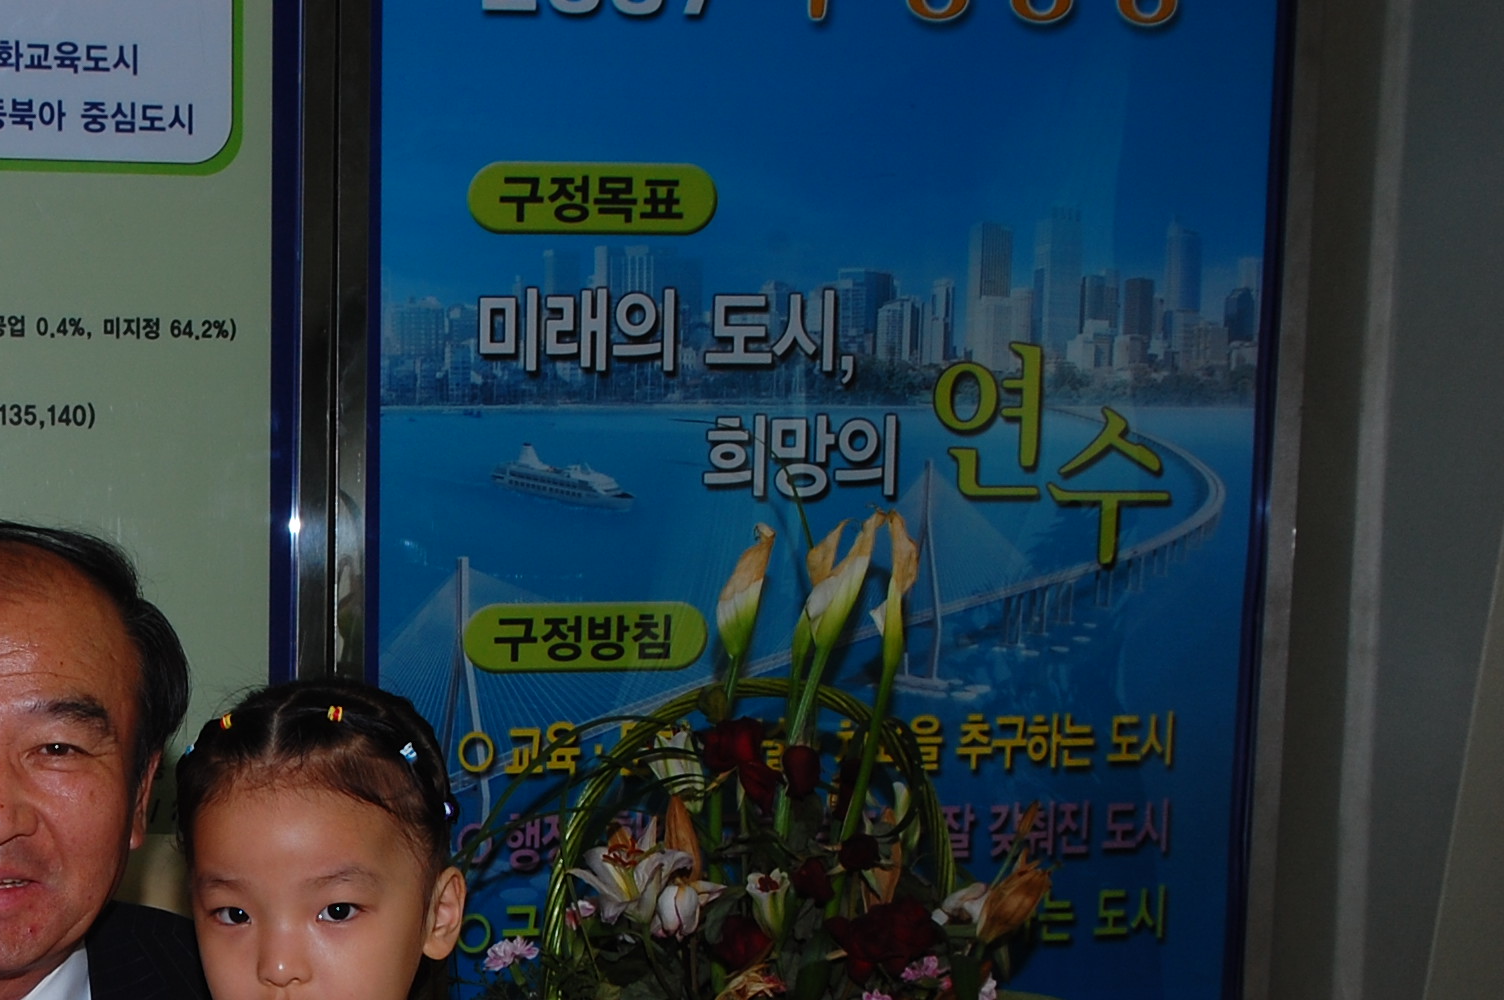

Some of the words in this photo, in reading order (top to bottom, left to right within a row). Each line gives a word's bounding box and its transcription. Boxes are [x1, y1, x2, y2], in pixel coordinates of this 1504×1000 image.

[80, 101, 194, 134] 중심도시
[499, 175, 684, 223] 구정목표
[103, 316, 160, 340] 미지정
[478, 287, 677, 373] 미래의
[704, 288, 856, 385] 도시,
[702, 414, 898, 499] 희망의
[933, 341, 1171, 567] 연수
[493, 614, 672, 663] 구정방침
[956, 712, 1094, 771] 추구하는
[1106, 710, 1175, 767] 도시
[1102, 797, 1170, 853] 도시
[1093, 884, 1167, 938] 도시
